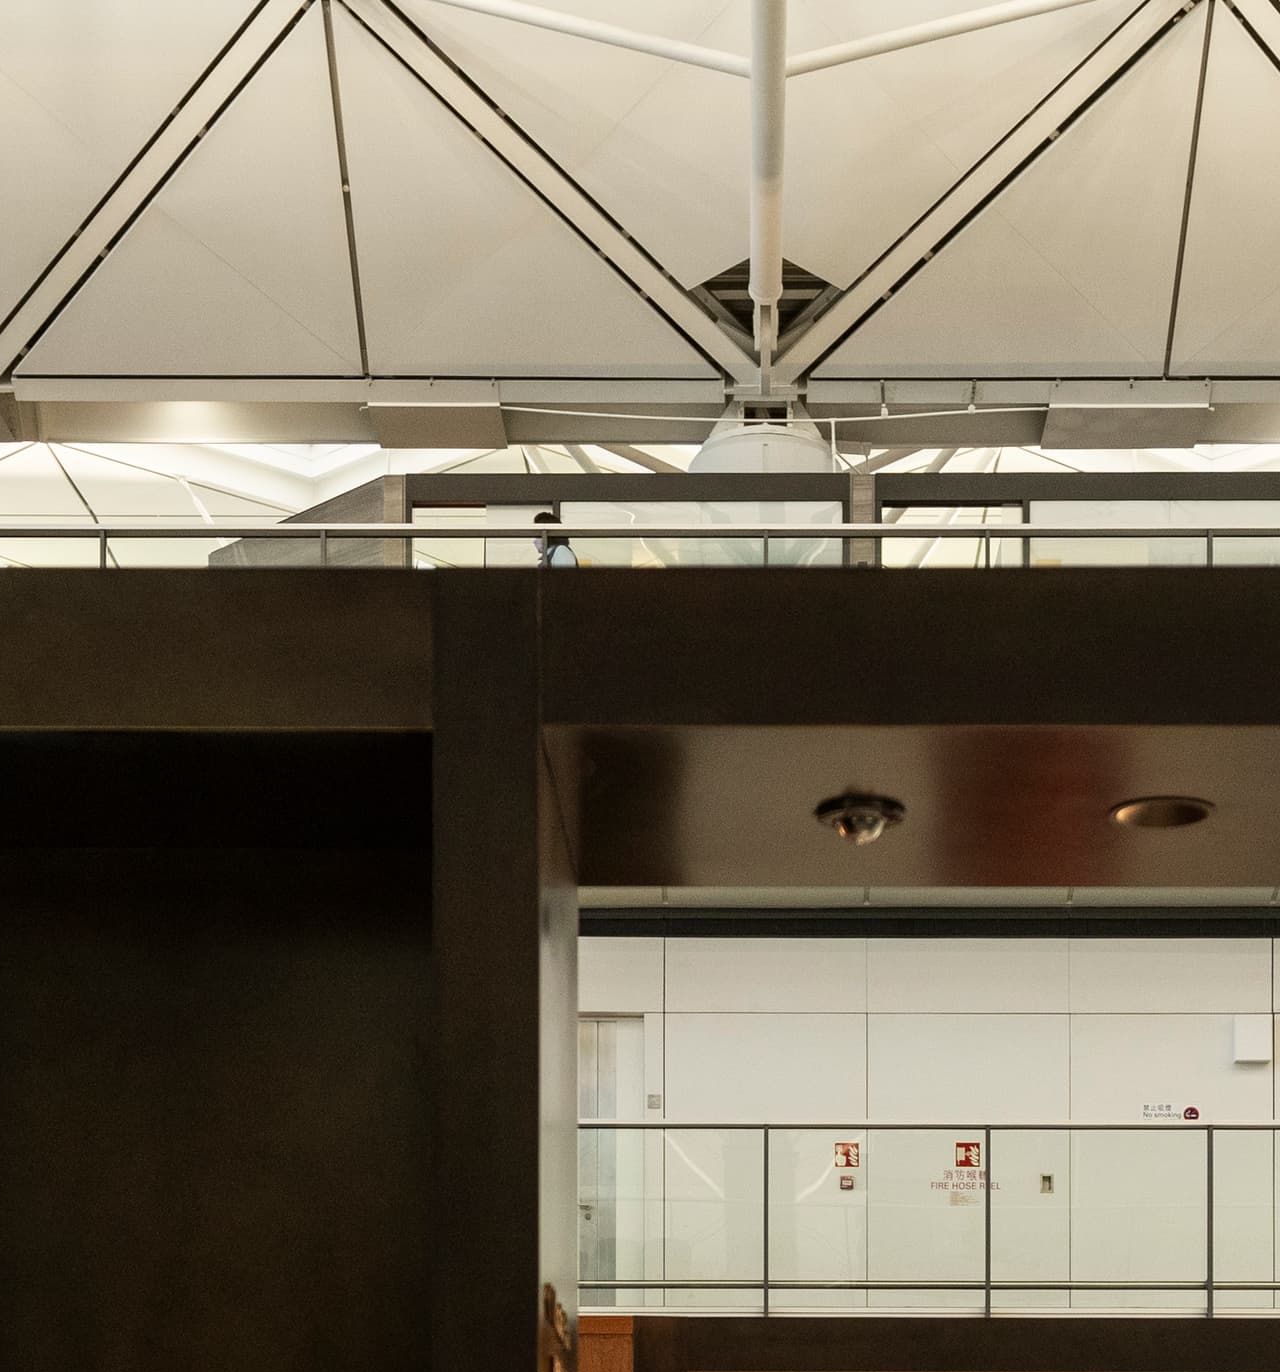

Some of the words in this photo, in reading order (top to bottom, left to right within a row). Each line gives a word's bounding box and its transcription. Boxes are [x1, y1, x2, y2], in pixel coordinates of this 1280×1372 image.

[1154, 1112, 1182, 1120] smoking
[930, 1182, 949, 1190] FIRE
[951, 1182, 977, 1190] HOSE
[979, 1182, 1001, 1190] REL
